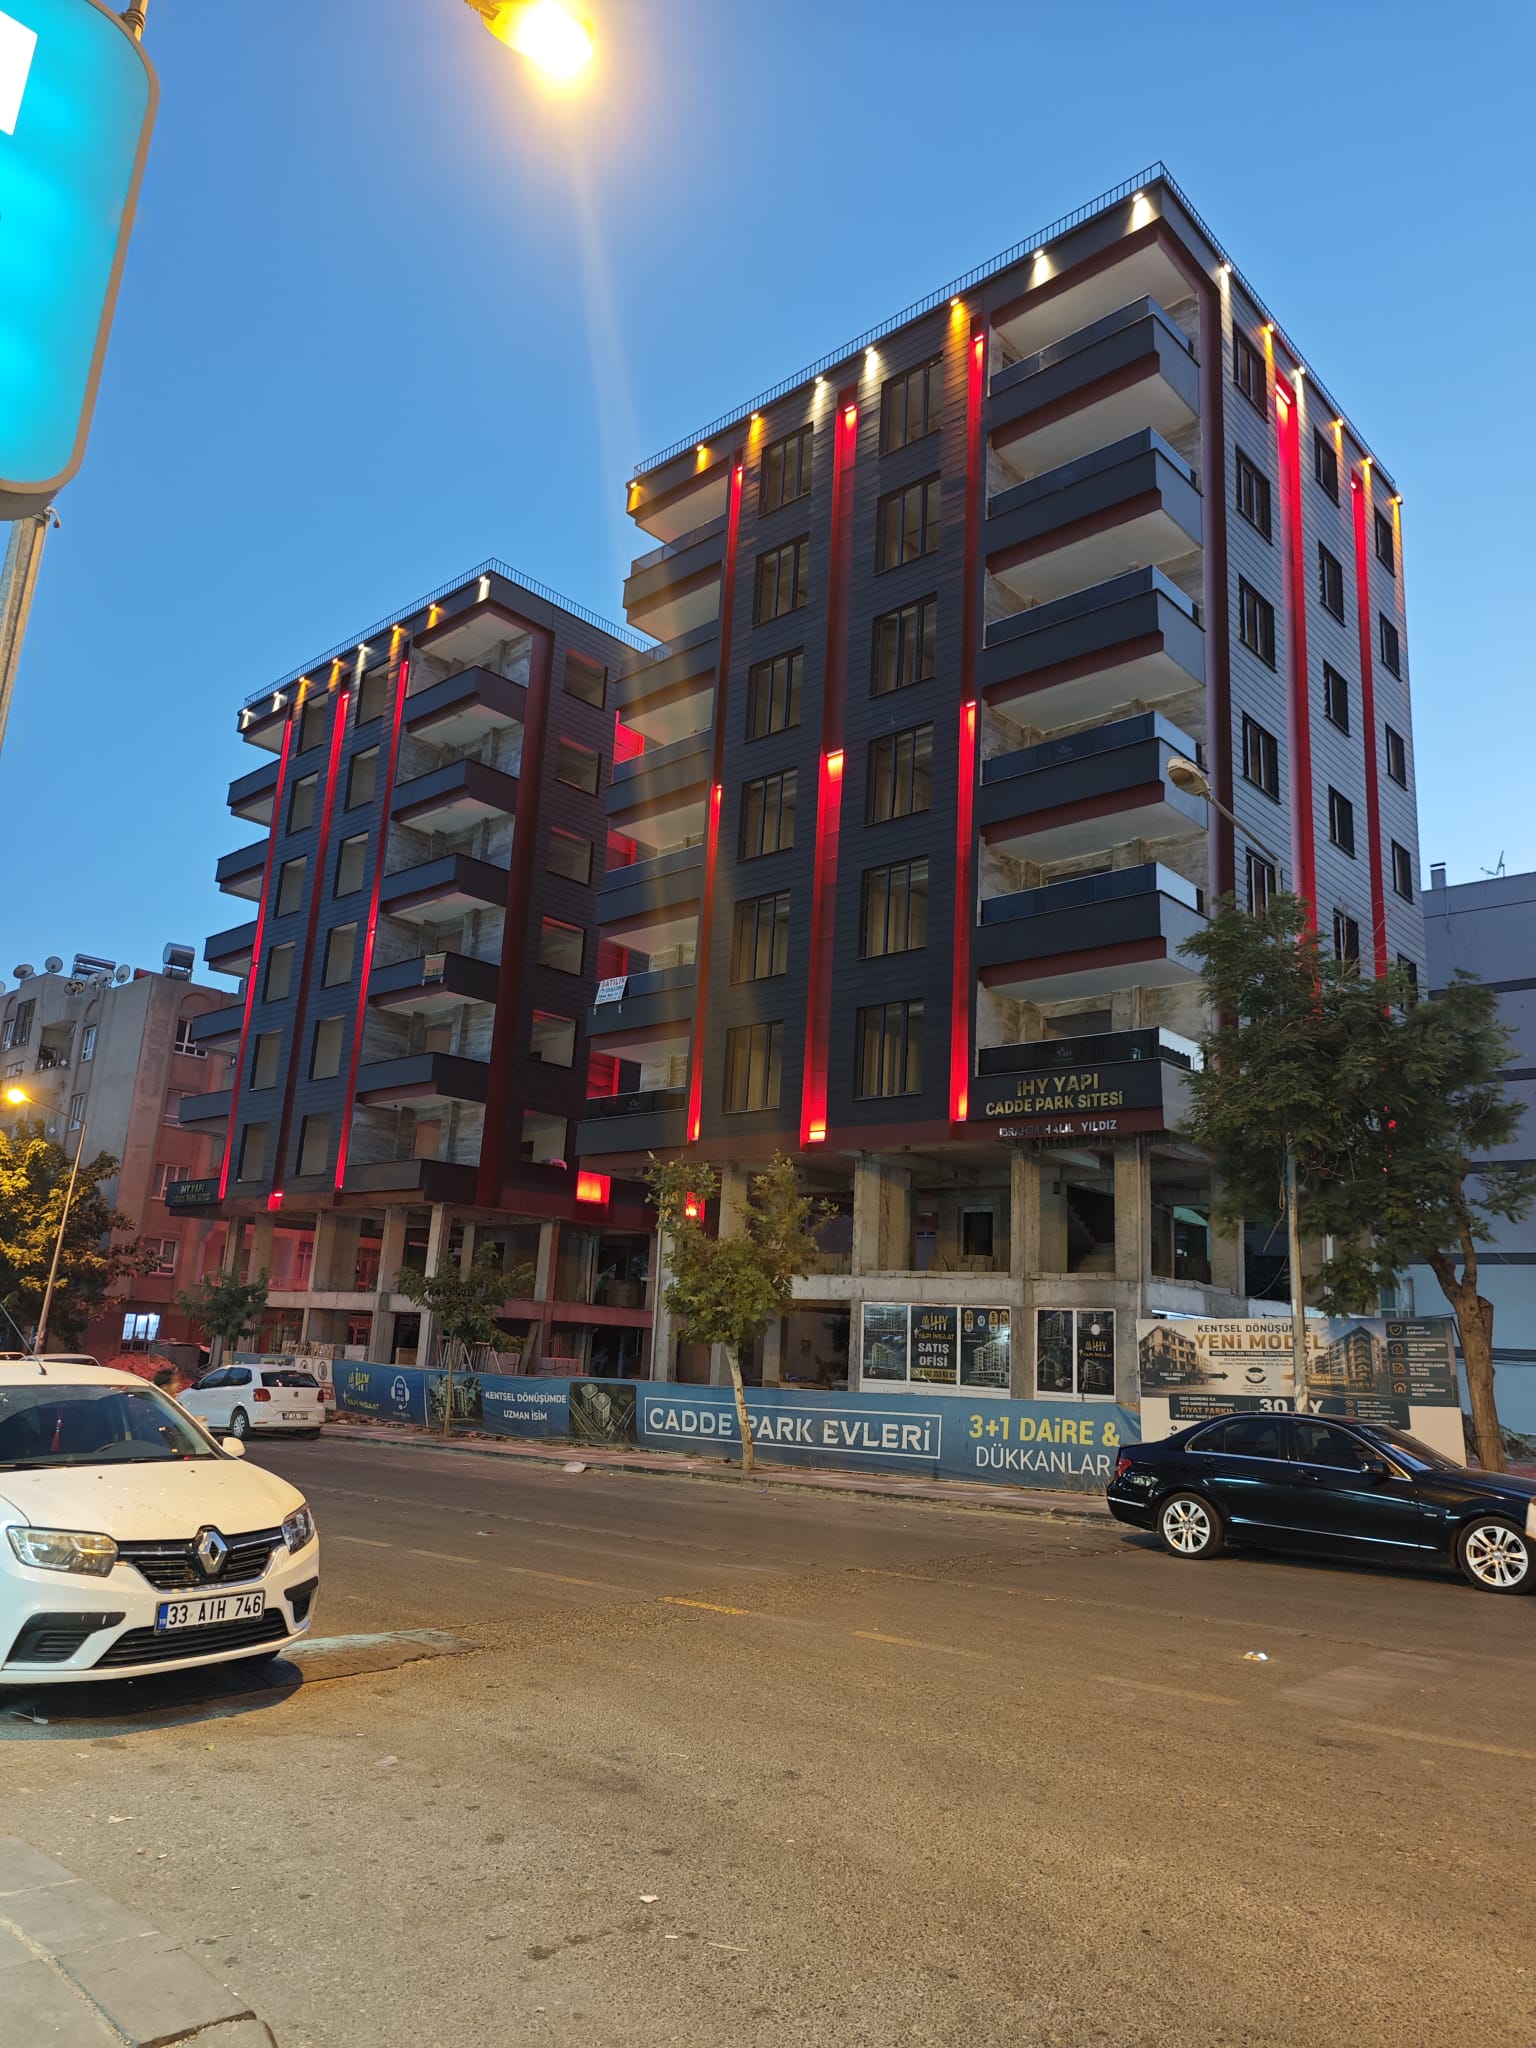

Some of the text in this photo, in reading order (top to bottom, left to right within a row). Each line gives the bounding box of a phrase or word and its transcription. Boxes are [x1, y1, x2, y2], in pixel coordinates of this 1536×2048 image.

[1053, 1073, 1099, 1093] YAPI
[985, 1090, 1124, 1116] CADDE PARK SİTESİ
[1081, 1119, 1117, 1131] YILDIZ
[1197, 1322, 1312, 1334] KENTSEL DÖNÜŞÜE
[917, 1343, 950, 1354] SATIŞ
[1194, 1334, 1242, 1350] YENİ
[919, 1355, 948, 1367] OFİSİ
[485, 1391, 567, 1405] KENTSEL DÖNÜŞÜMDE
[1259, 1398, 1288, 1413] 30
[503, 1409, 548, 1421] UZMAN İSİM
[1180, 1406, 1203, 1414] FİYAT
[649, 1407, 931, 1451] CADDE PARK EVLERİ
[969, 1414, 1120, 1447] 3+1 DAİRE &
[975, 1446, 1112, 1477] DÜKKANLAR
[168, 1595, 261, 1625] 33 AIH 746
